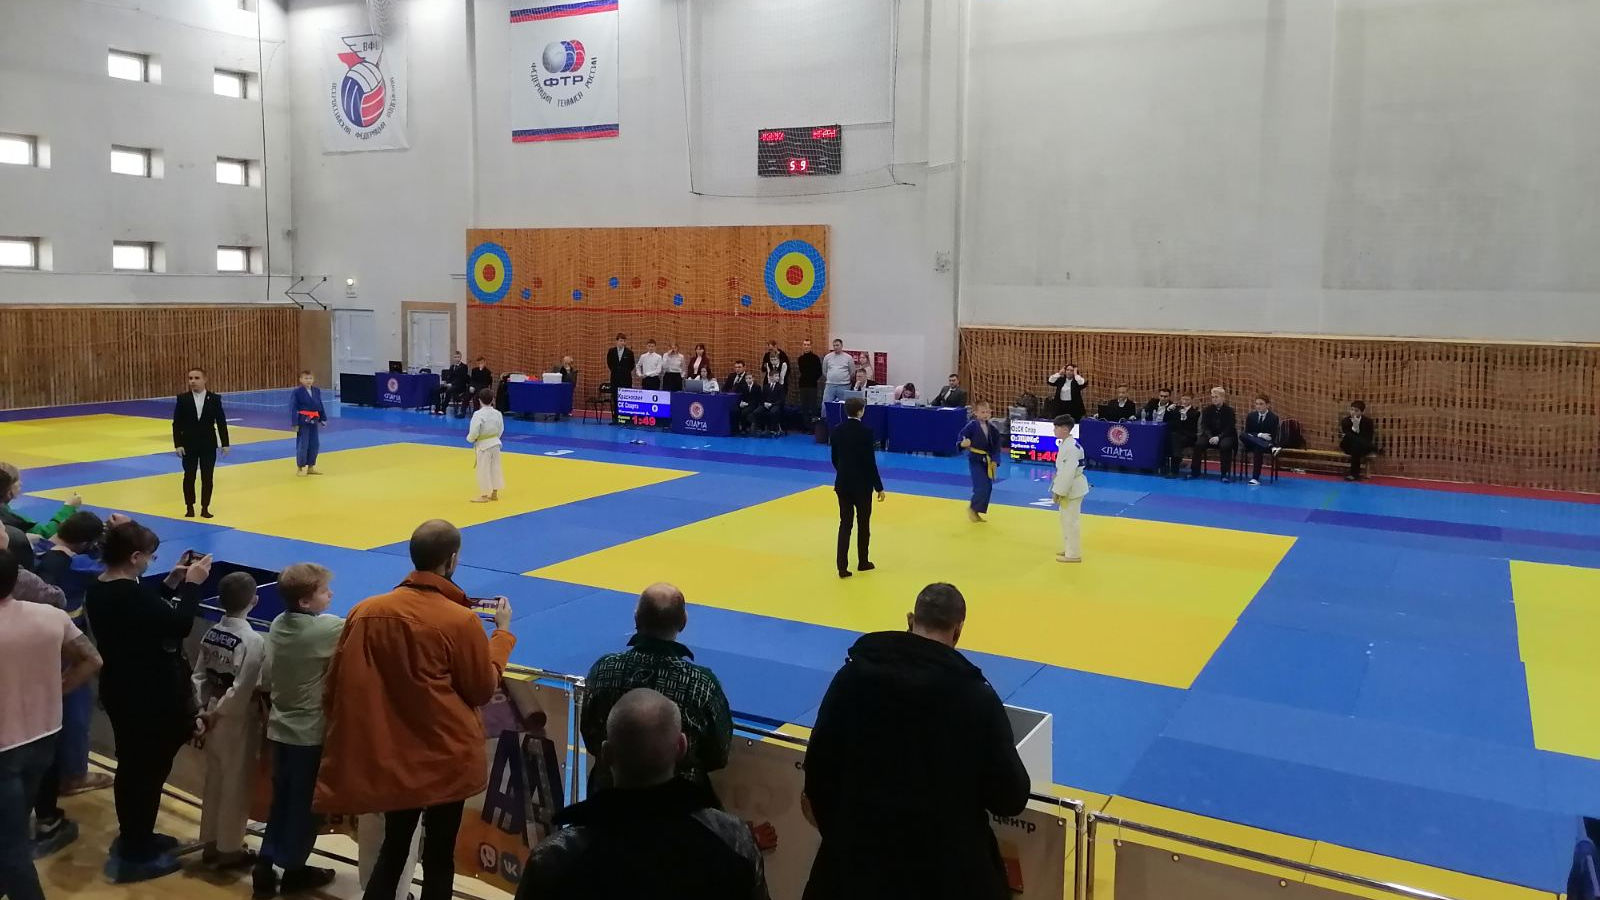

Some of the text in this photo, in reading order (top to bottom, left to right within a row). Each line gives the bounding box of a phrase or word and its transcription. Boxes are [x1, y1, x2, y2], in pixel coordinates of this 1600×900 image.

[543, 75, 584, 87] ФТР
[651, 404, 659, 413] 0
[632, 416, 656, 426] 1:49
